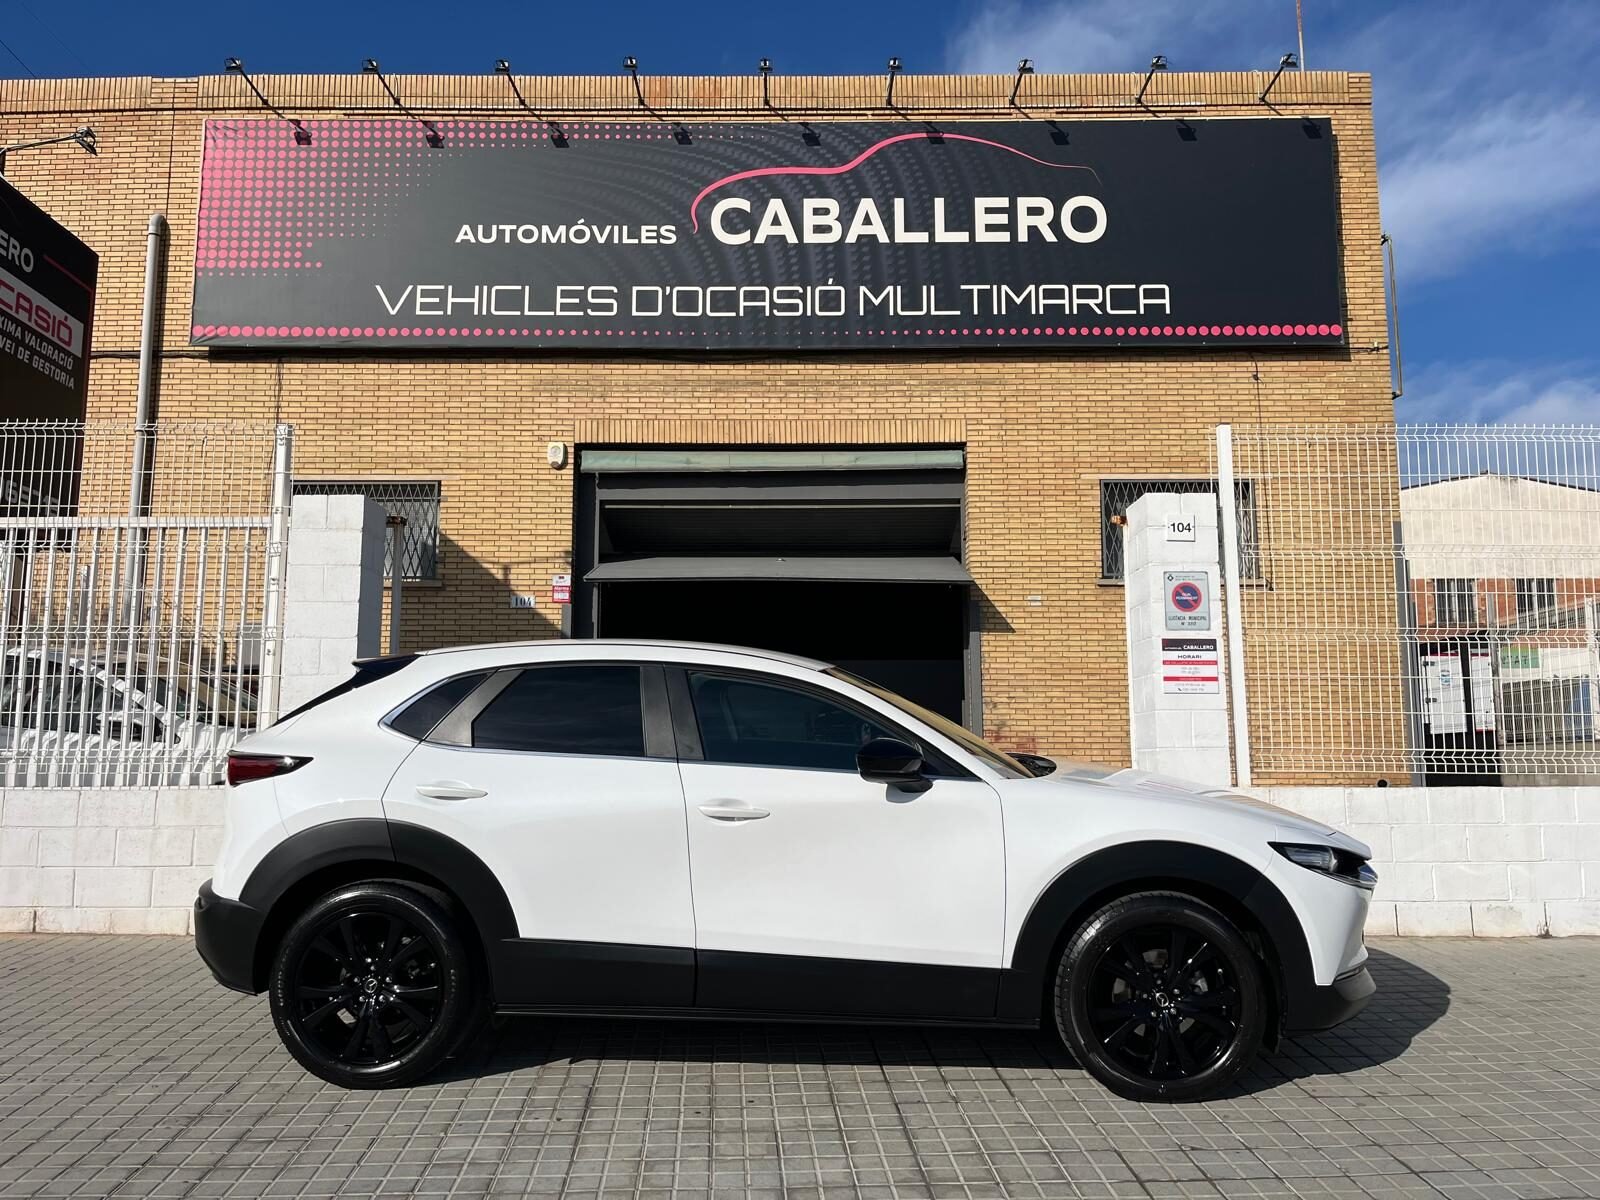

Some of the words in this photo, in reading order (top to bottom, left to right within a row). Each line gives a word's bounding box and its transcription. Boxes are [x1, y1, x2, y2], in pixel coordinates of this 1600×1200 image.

[455, 218, 677, 245] AUTOMÓVILES
[710, 195, 1108, 245] CABALLERO
[375, 284, 618, 316] VEHICLES
[631, 277, 846, 317] D'OCASIÓ
[858, 283, 1171, 317] MULTIMARCA
[17, 346, 31, 364] DE
[32, 355, 75, 390] GESTORIA
[25, 330, 74, 370] VALORACIÓ
[1170, 522, 1192, 533] 104
[515, 597, 532, 607] 104
